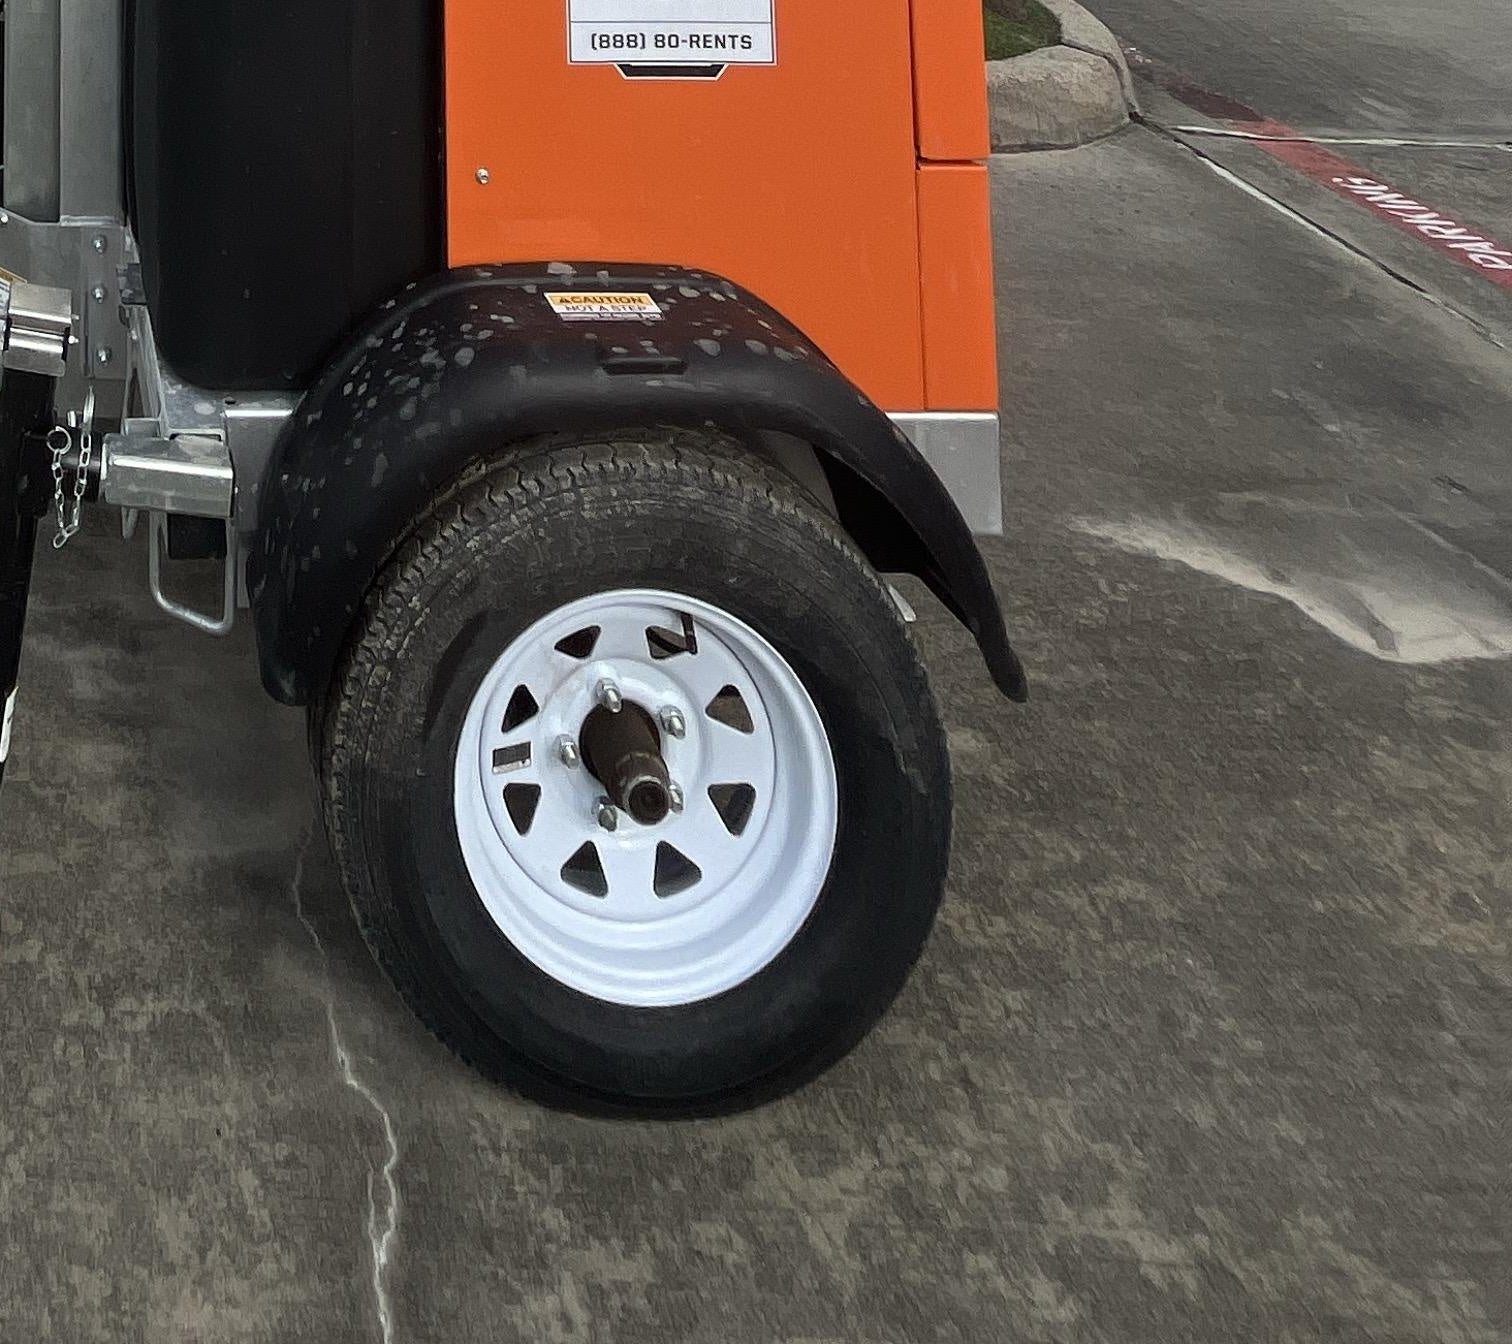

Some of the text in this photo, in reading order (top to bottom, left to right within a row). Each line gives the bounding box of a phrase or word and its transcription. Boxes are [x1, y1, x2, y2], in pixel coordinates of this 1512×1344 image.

[591, 32, 752, 51] (888) 80-RENTS
[1331, 176, 1512, 270] PARKING
[569, 295, 645, 304] CAUTION
